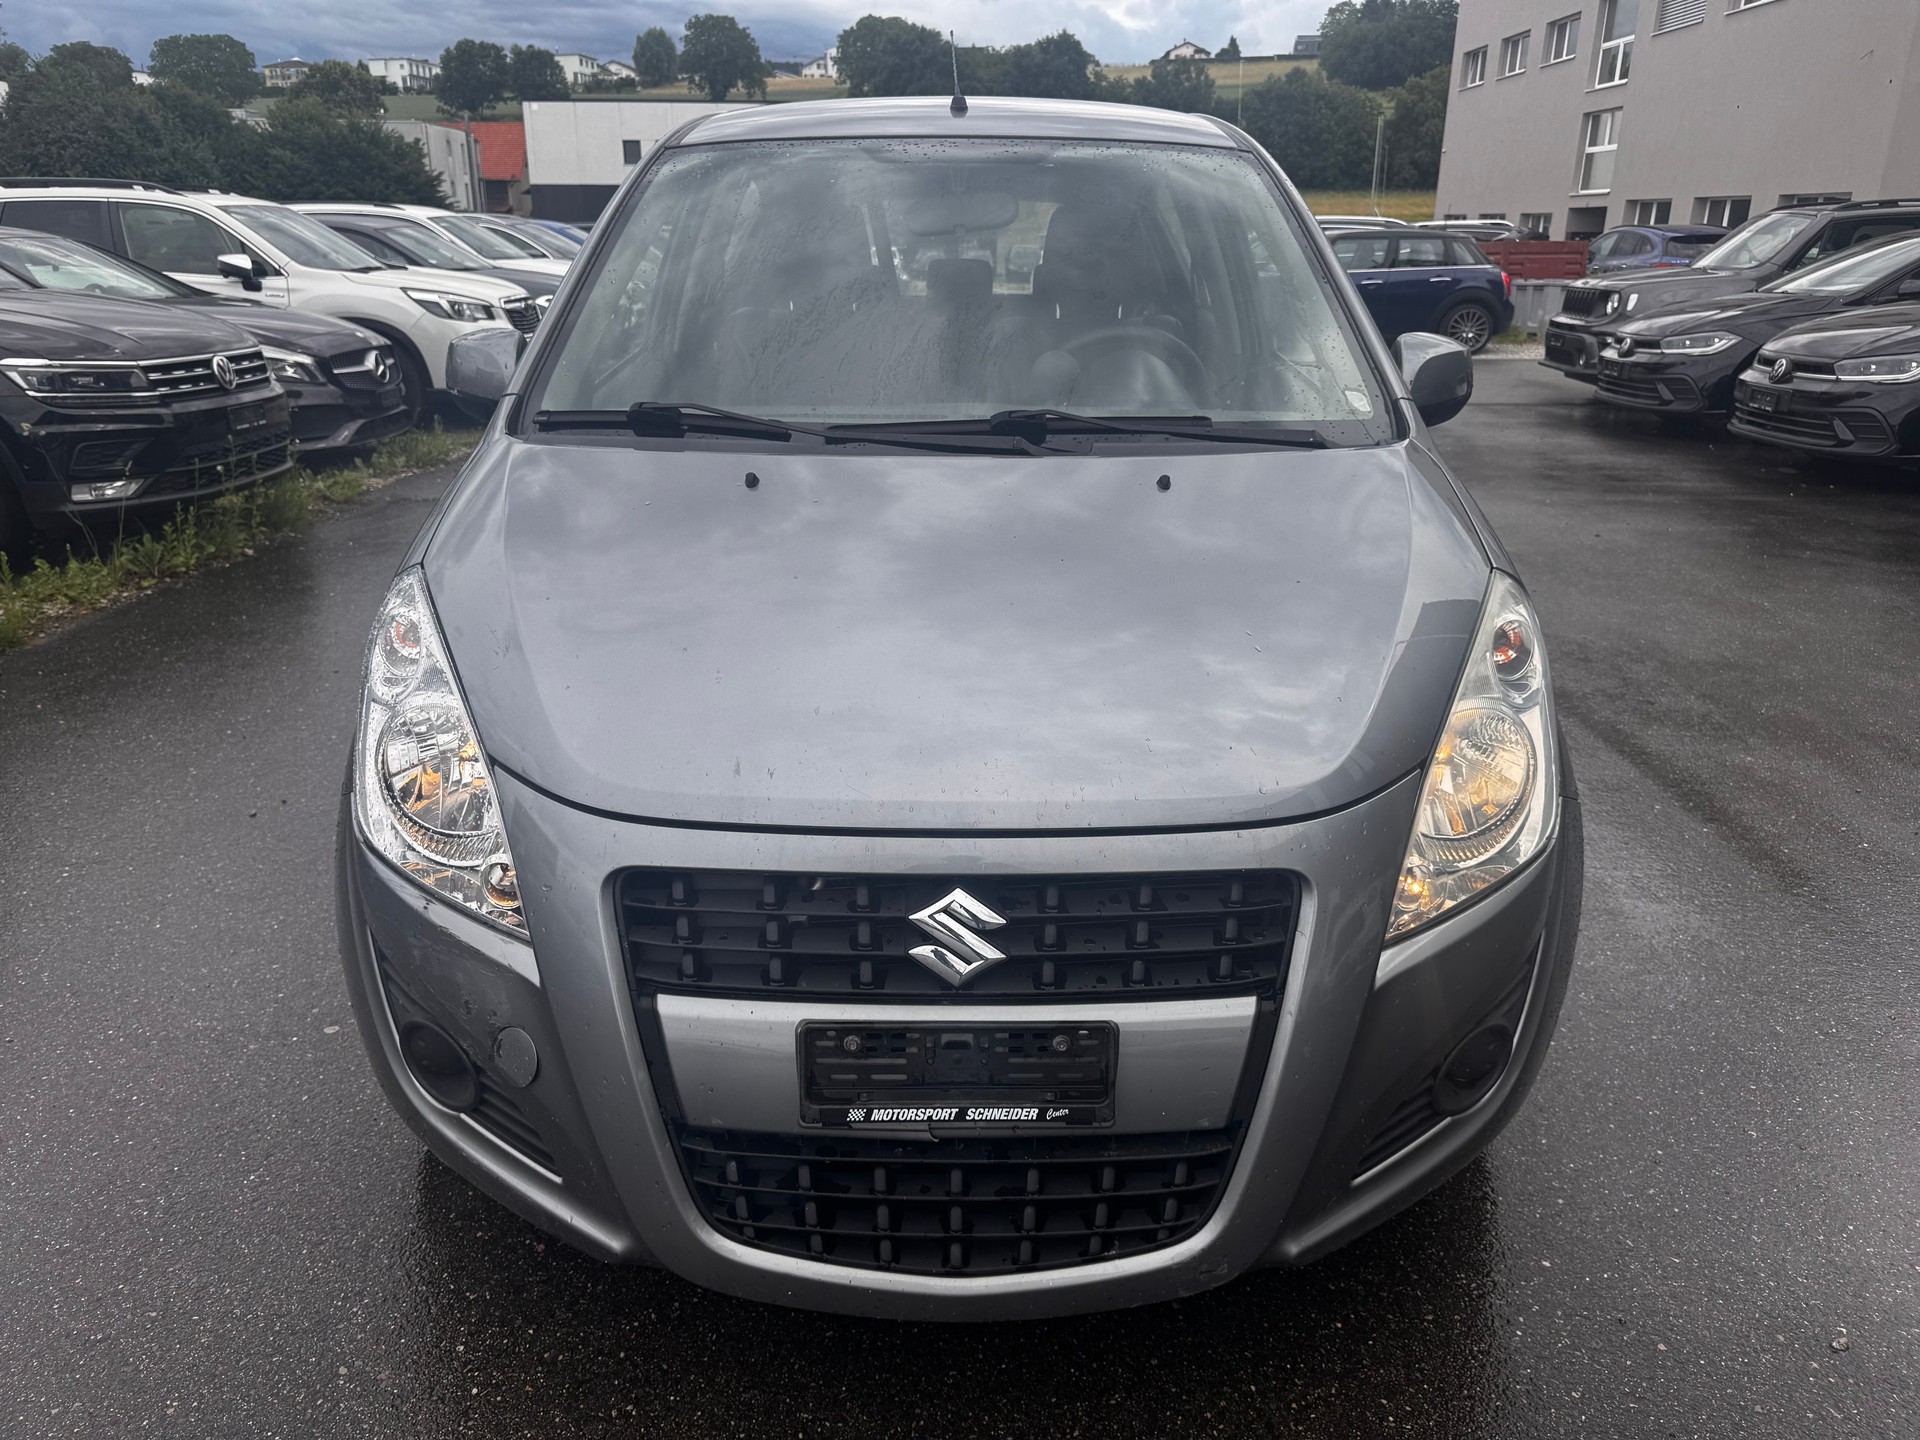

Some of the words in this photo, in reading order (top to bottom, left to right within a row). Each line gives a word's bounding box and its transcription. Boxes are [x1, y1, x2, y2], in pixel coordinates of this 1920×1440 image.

[870, 1108, 959, 1121] MOTORSPORT
[965, 1107, 1039, 1120] SCHNEIDER
[1046, 1107, 1069, 1120] Center
